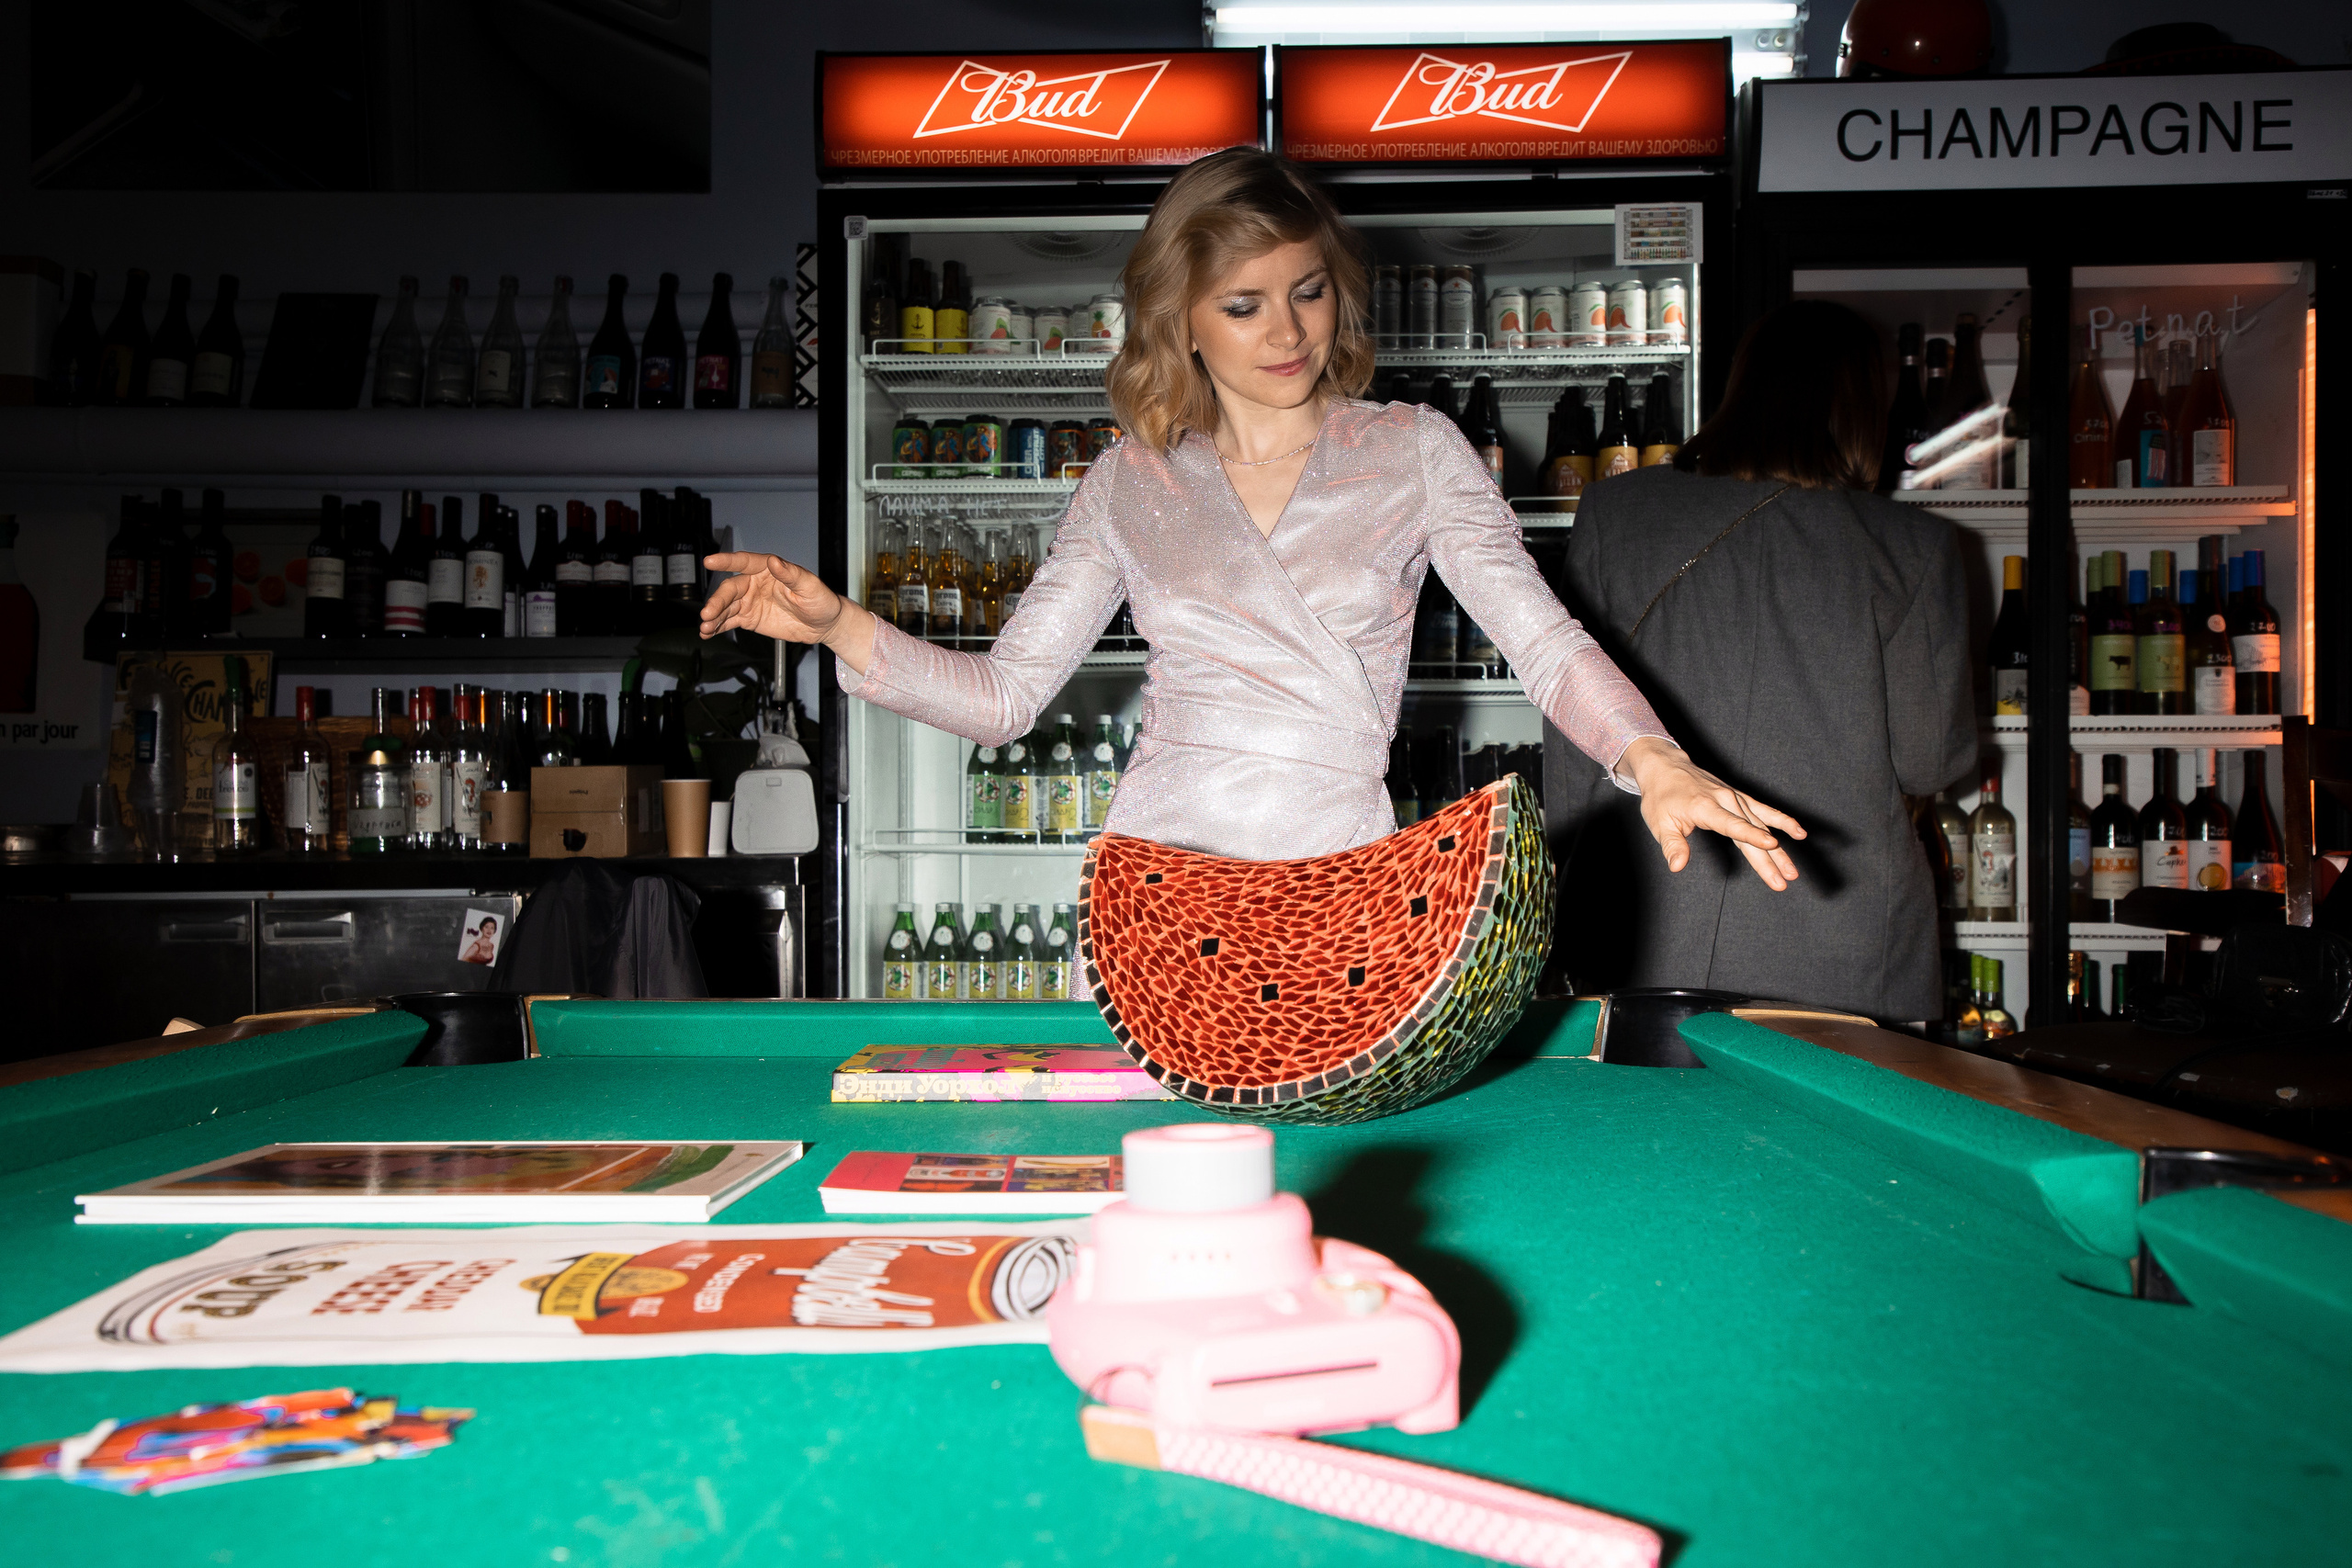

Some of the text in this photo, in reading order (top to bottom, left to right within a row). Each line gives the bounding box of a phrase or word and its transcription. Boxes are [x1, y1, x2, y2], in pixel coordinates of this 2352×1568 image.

[961, 69, 1102, 124] Bud
[1419, 62, 1564, 117] Bud
[1837, 99, 2294, 163] CHAMPAGNE
[831, 149, 910, 165] ЧРЕЗМЕРНОЕ
[912, 148, 1009, 164] УПОТРЕБЛЕНИЕ
[1012, 147, 1077, 164] АЛКОГОЛЯ
[1079, 147, 1126, 163] ВРЕДИТ
[1128, 146, 1182, 163] ВАШЕМУ
[1287, 139, 1718, 159] ЧРЕЗМЕРНОЕ УПОТРЕБЛЕНИЕ АЛКОГОЛЯ ВРЕДИТ ВАШЕМУ ЗДОРОВЬЮ
[12, 723, 39, 743] par
[40, 719, 79, 744] jour
[838, 1073, 1016, 1099] Энди Уорхол
[1041, 1085, 1122, 1096] искусство
[1042, 1074, 1116, 1087] и русское
[179, 1259, 347, 1319] SOUP
[311, 1260, 456, 1316] CHEESE
